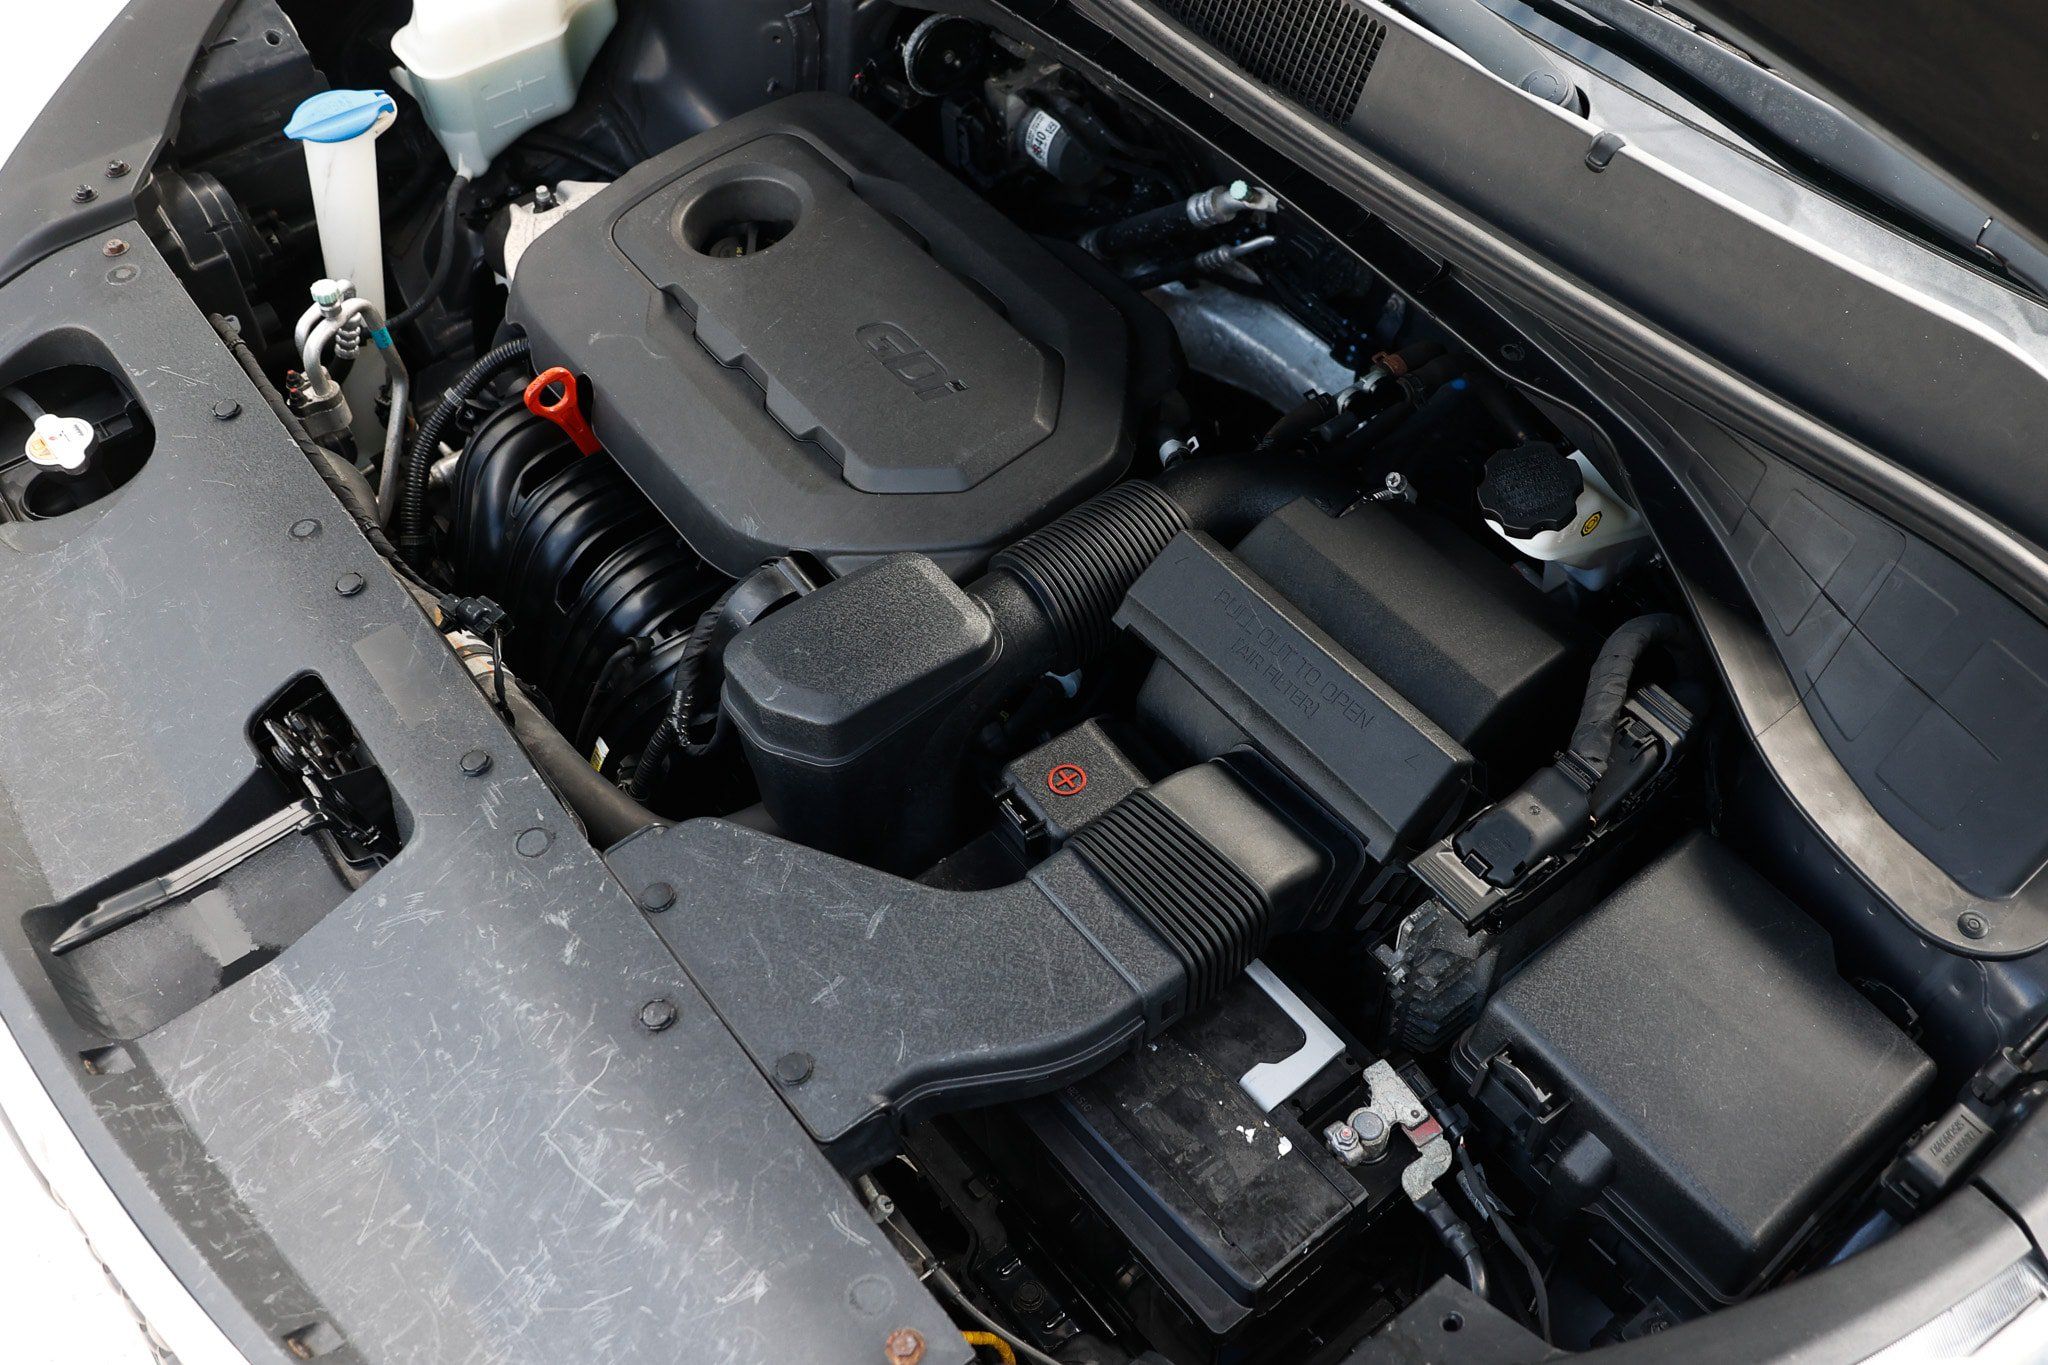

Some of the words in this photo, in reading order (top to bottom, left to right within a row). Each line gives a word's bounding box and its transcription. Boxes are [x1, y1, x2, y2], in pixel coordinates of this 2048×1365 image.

[1214, 587, 1254, 635] PULL
[1257, 625, 1299, 663] OUT
[1297, 656, 1322, 687] TO
[1320, 681, 1376, 730] OPEN
[1262, 668, 1321, 720] FILTER)
